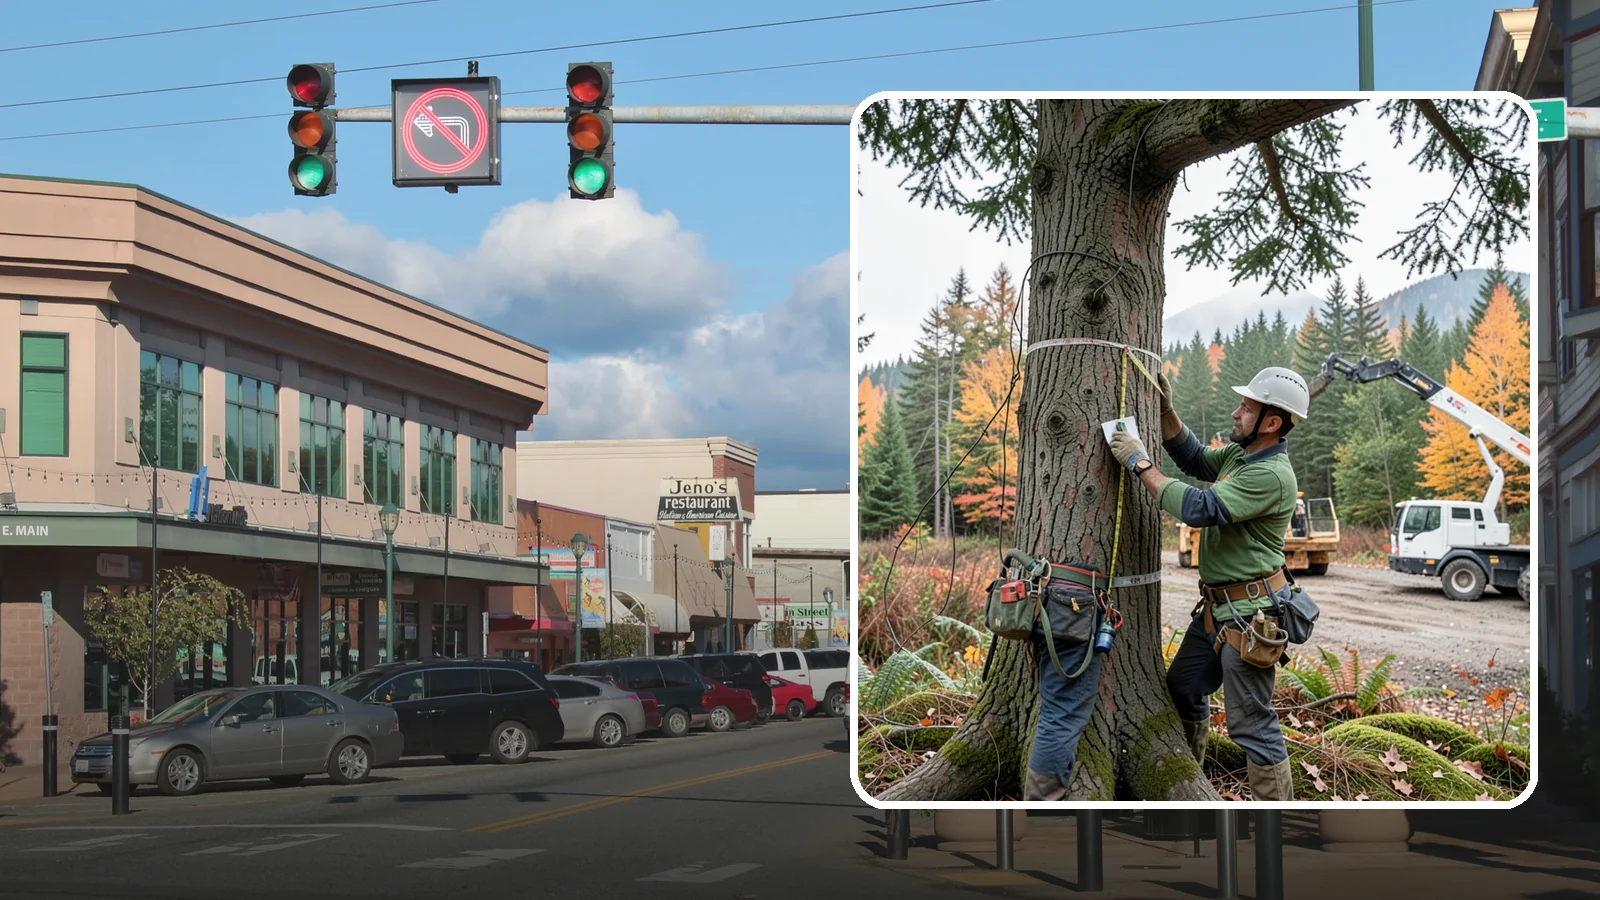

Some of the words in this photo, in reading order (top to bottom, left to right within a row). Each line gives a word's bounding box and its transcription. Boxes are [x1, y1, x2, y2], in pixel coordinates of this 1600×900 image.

[670, 480, 727, 494] Jeno's
[665, 497, 731, 509] restaurant
[658, 510, 681, 519] Italian
[685, 510, 714, 519] American
[714, 509, 737, 519] Cuisine
[2, 525, 13, 536] E.
[15, 525, 49, 536] MAIN
[798, 608, 828, 616] Street
